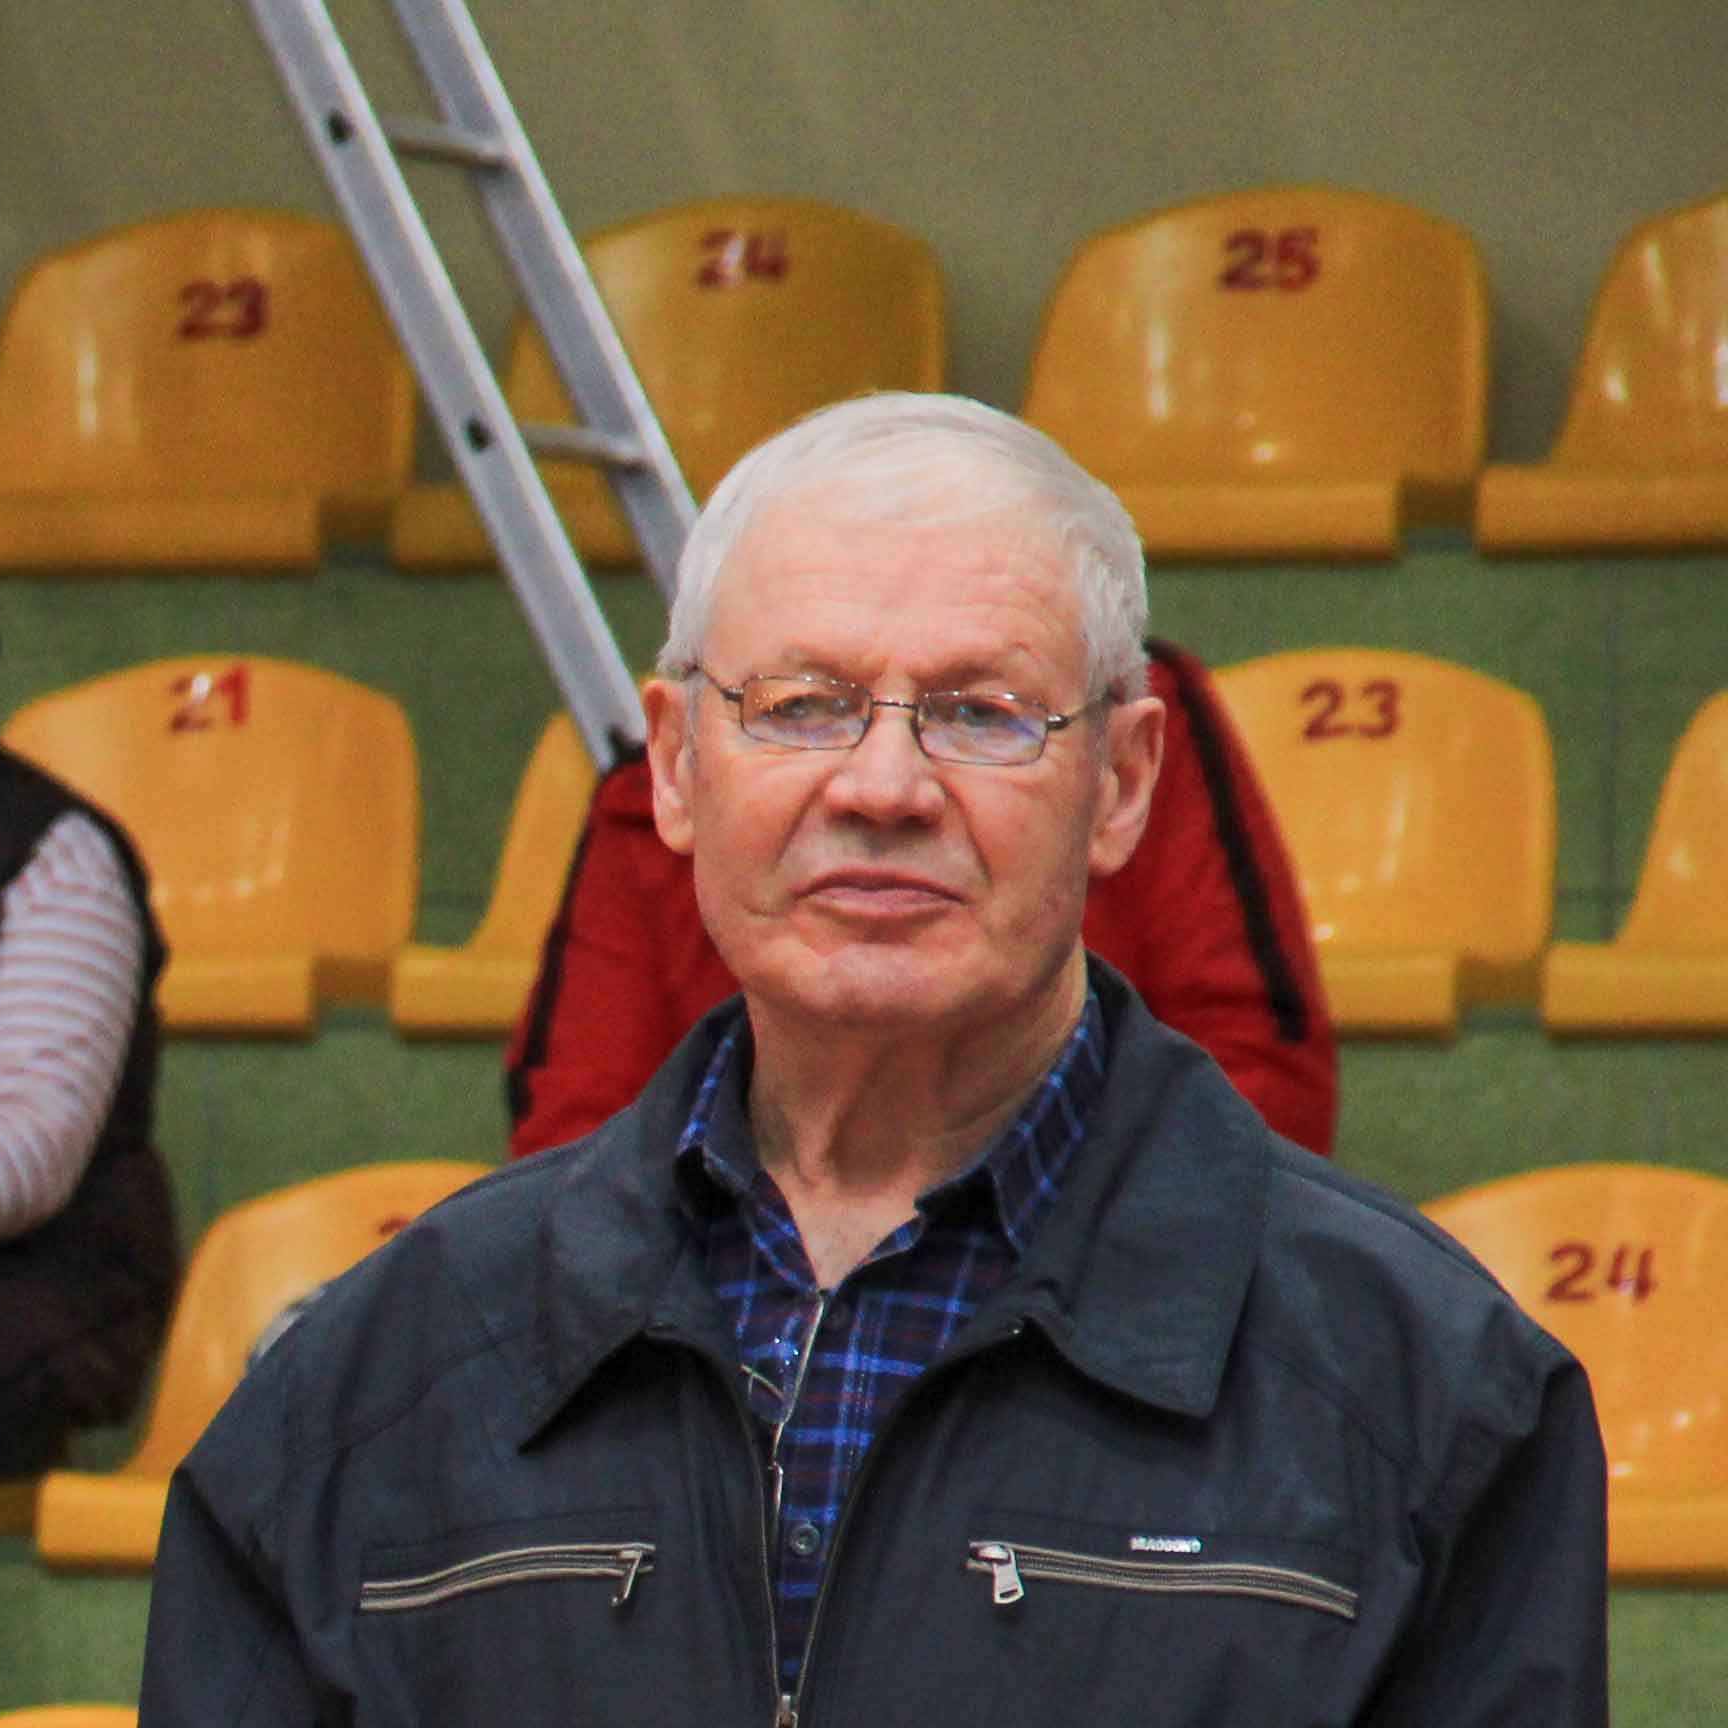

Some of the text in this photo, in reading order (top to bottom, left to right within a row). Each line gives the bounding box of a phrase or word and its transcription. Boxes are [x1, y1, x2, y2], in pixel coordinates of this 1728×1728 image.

[696, 231, 791, 288] 24
[1220, 229, 1320, 291] 25
[177, 279, 268, 341] 23
[168, 662, 251, 734] 21
[1300, 680, 1401, 743] 23
[1545, 1241, 1658, 1305] 24
